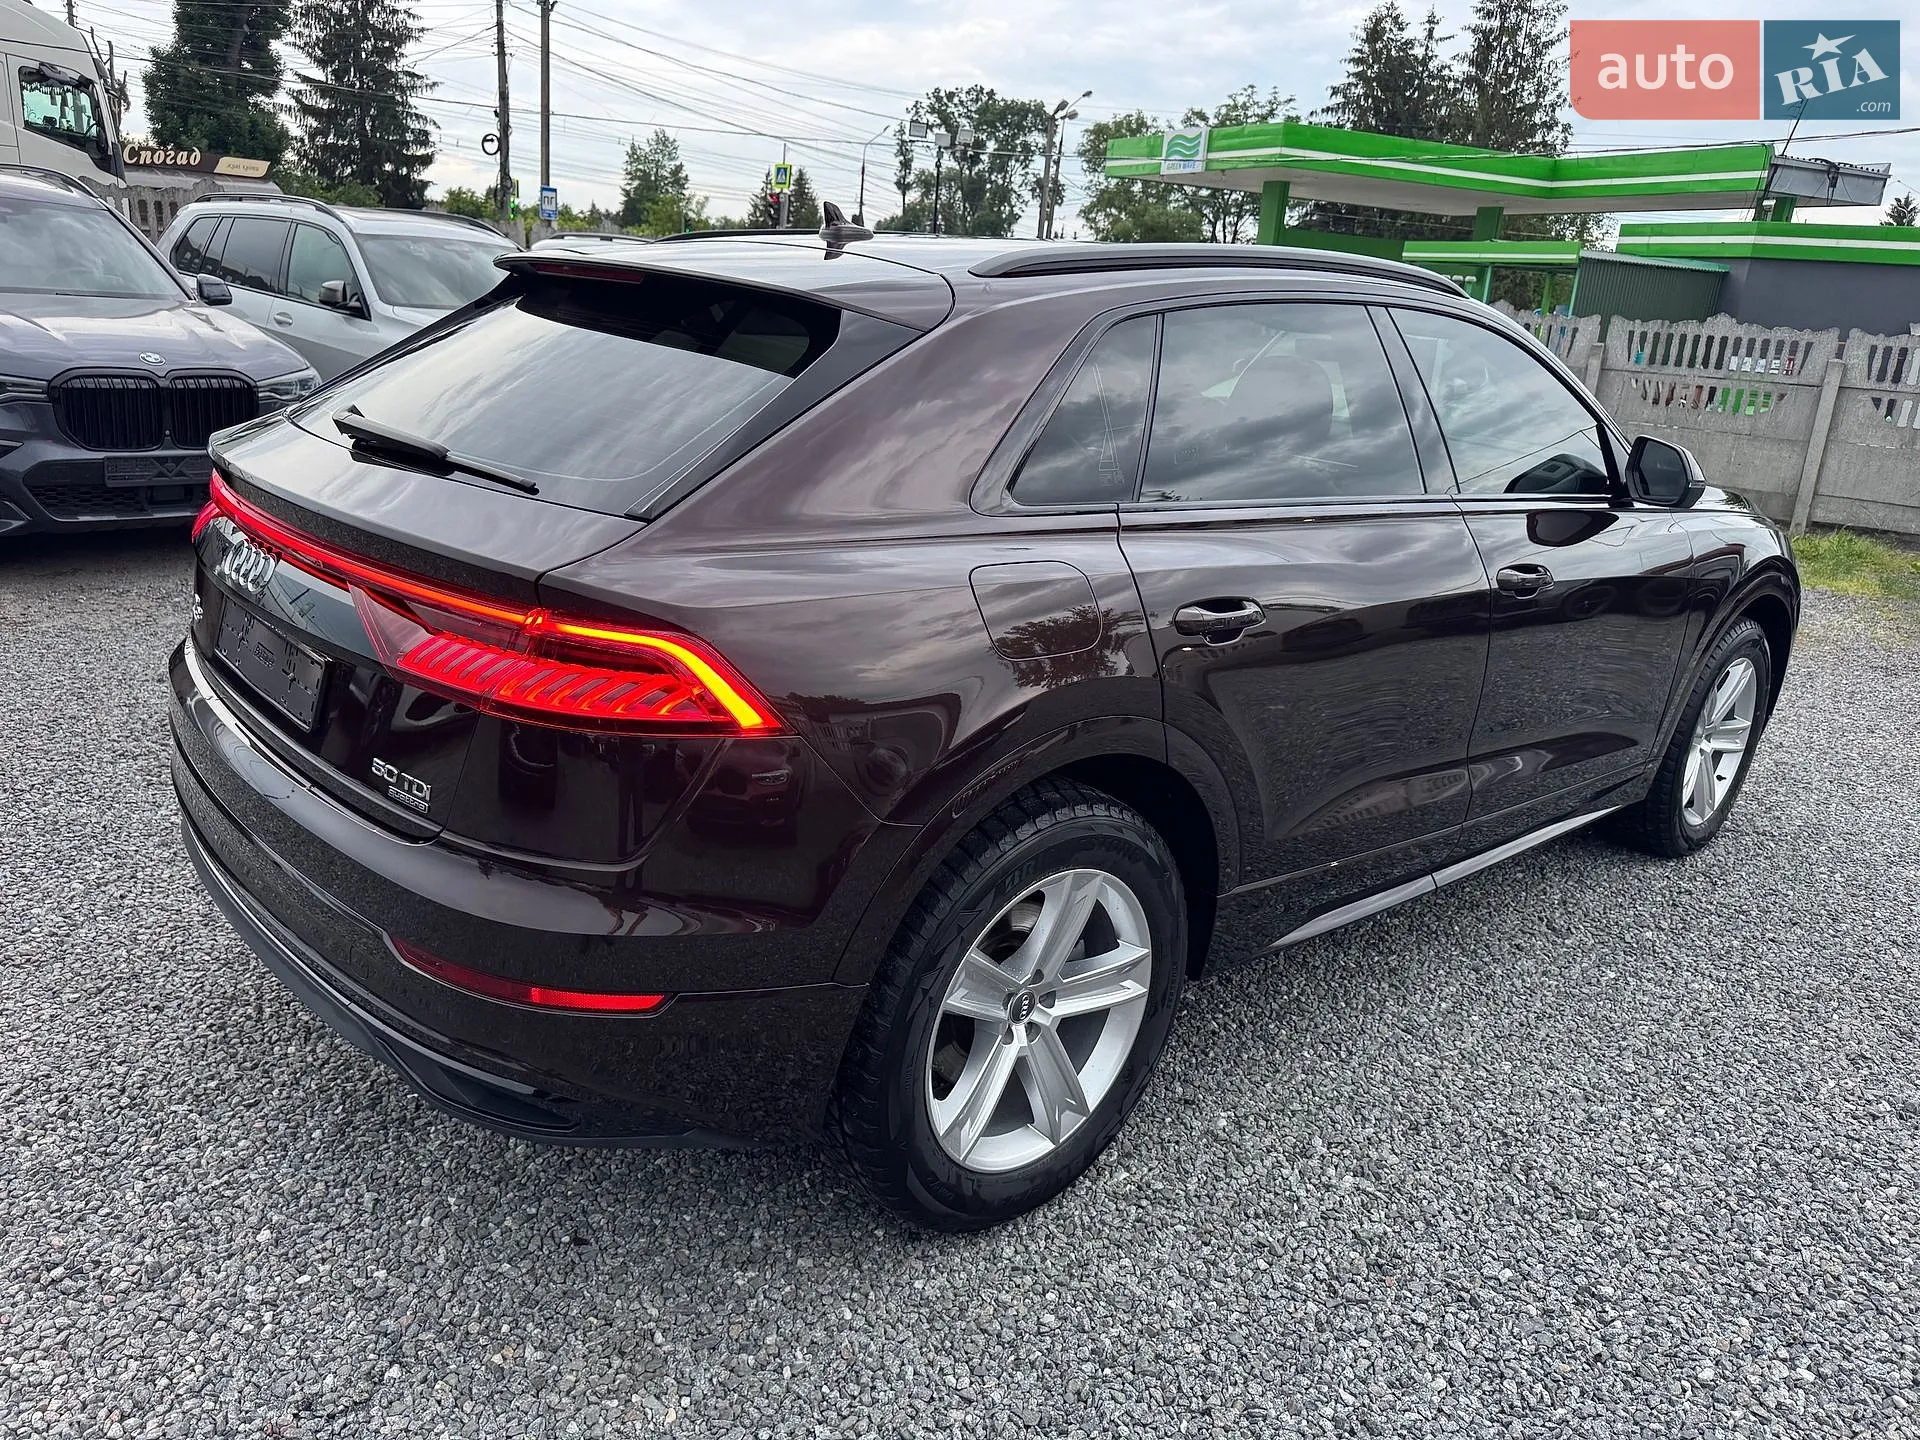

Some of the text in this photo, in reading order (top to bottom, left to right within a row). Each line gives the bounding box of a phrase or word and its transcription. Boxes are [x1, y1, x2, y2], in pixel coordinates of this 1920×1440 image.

[123, 144, 201, 166] Спогад
[371, 757, 431, 801] 50 TDI
